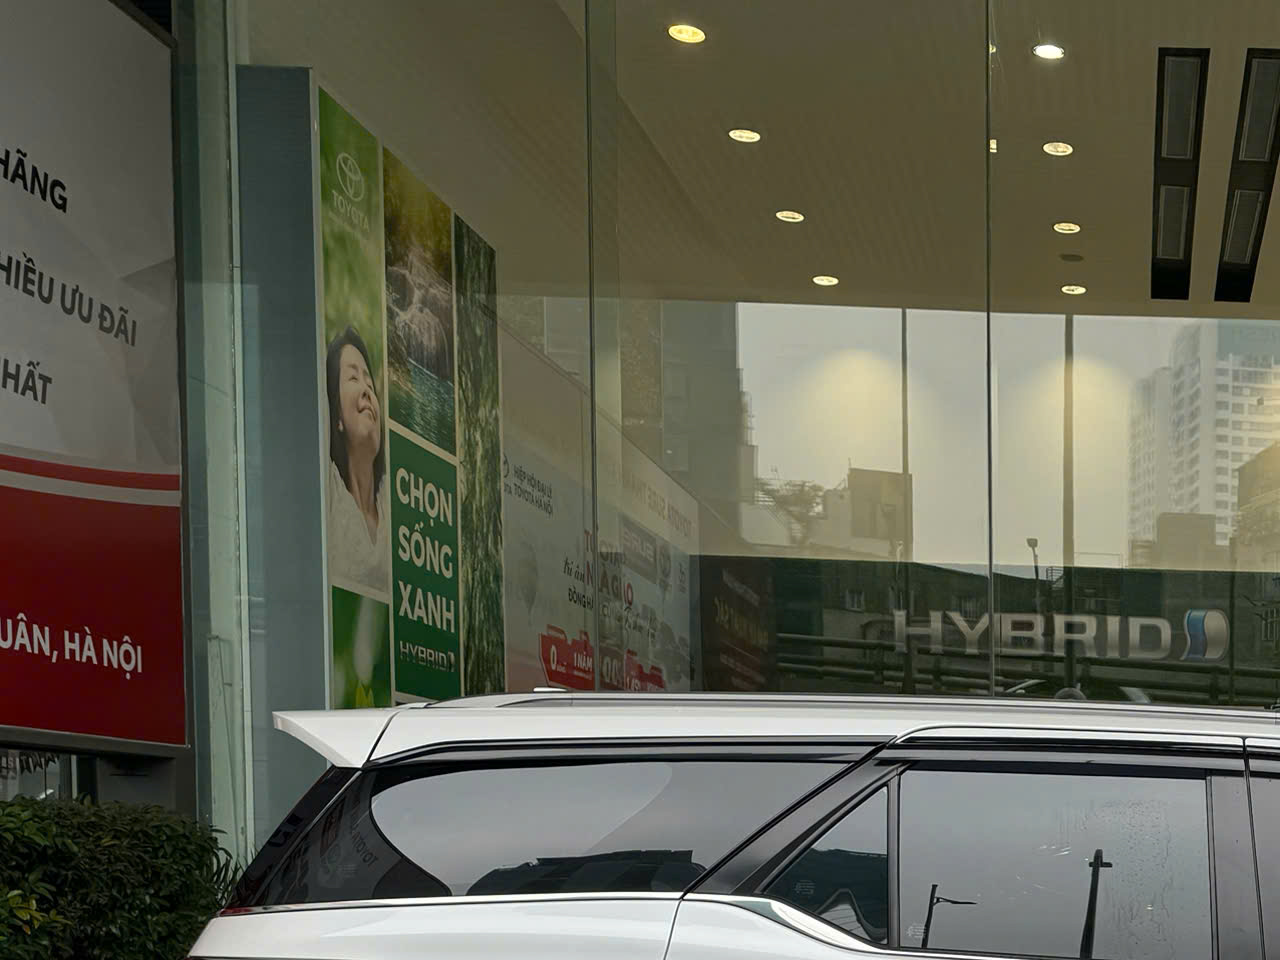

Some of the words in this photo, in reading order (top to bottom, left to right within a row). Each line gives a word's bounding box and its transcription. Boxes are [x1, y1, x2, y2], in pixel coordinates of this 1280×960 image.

[332, 190, 369, 233] TOYOTA
[60, 282, 93, 324] ƯU
[98, 306, 137, 347] ĐÃI
[396, 467, 452, 527] CHỌN
[398, 521, 453, 579] SỐNG
[399, 580, 455, 633] XANH
[64, 626, 97, 664] HÀ
[103, 635, 142, 680] NỘI
[400, 640, 448, 667] HYBRID
[893, 609, 1172, 660] HYBRID
